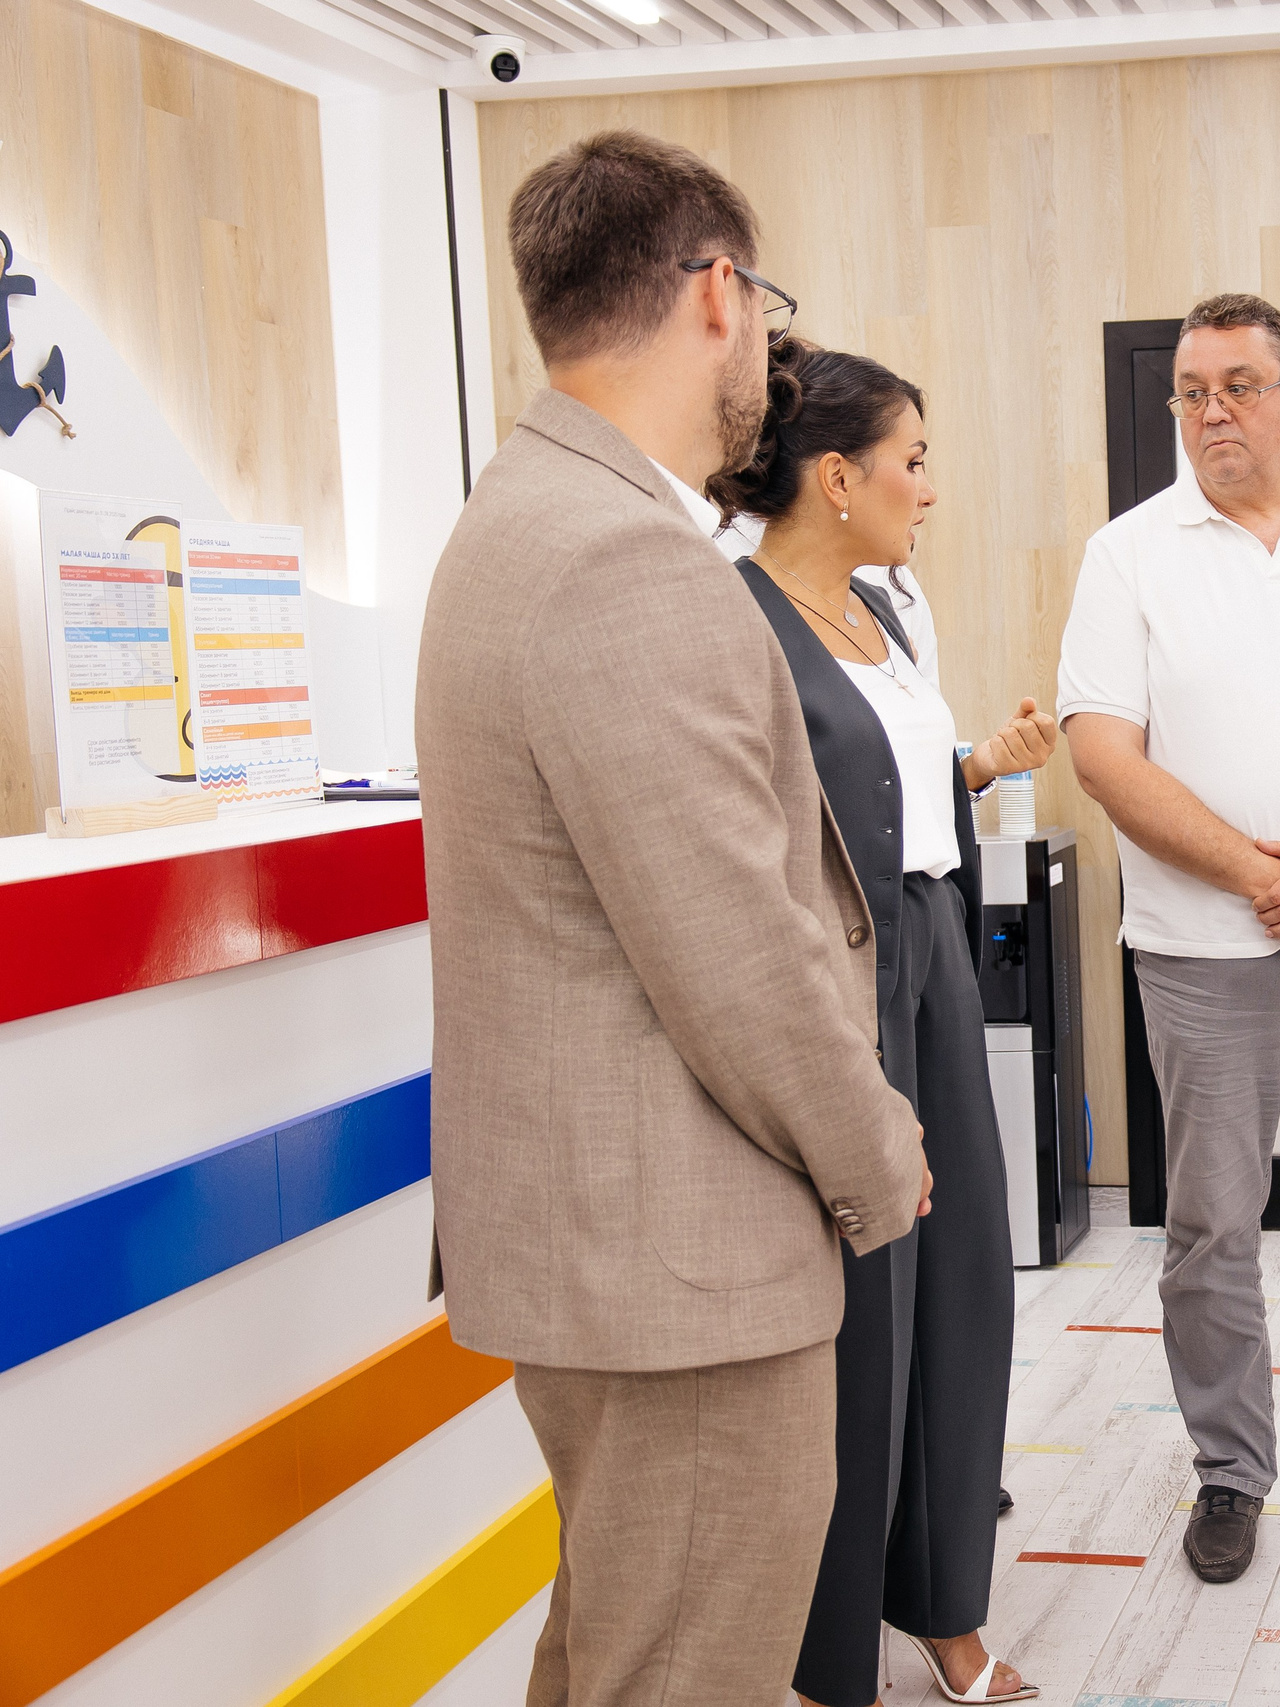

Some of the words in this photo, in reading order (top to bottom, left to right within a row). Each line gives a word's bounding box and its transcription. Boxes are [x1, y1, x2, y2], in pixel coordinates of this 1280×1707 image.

[188, 538, 214, 546] СРЕДНЯЯ
[60, 549, 83, 557] МАЛАЯ
[101, 552, 111, 560] ДО
